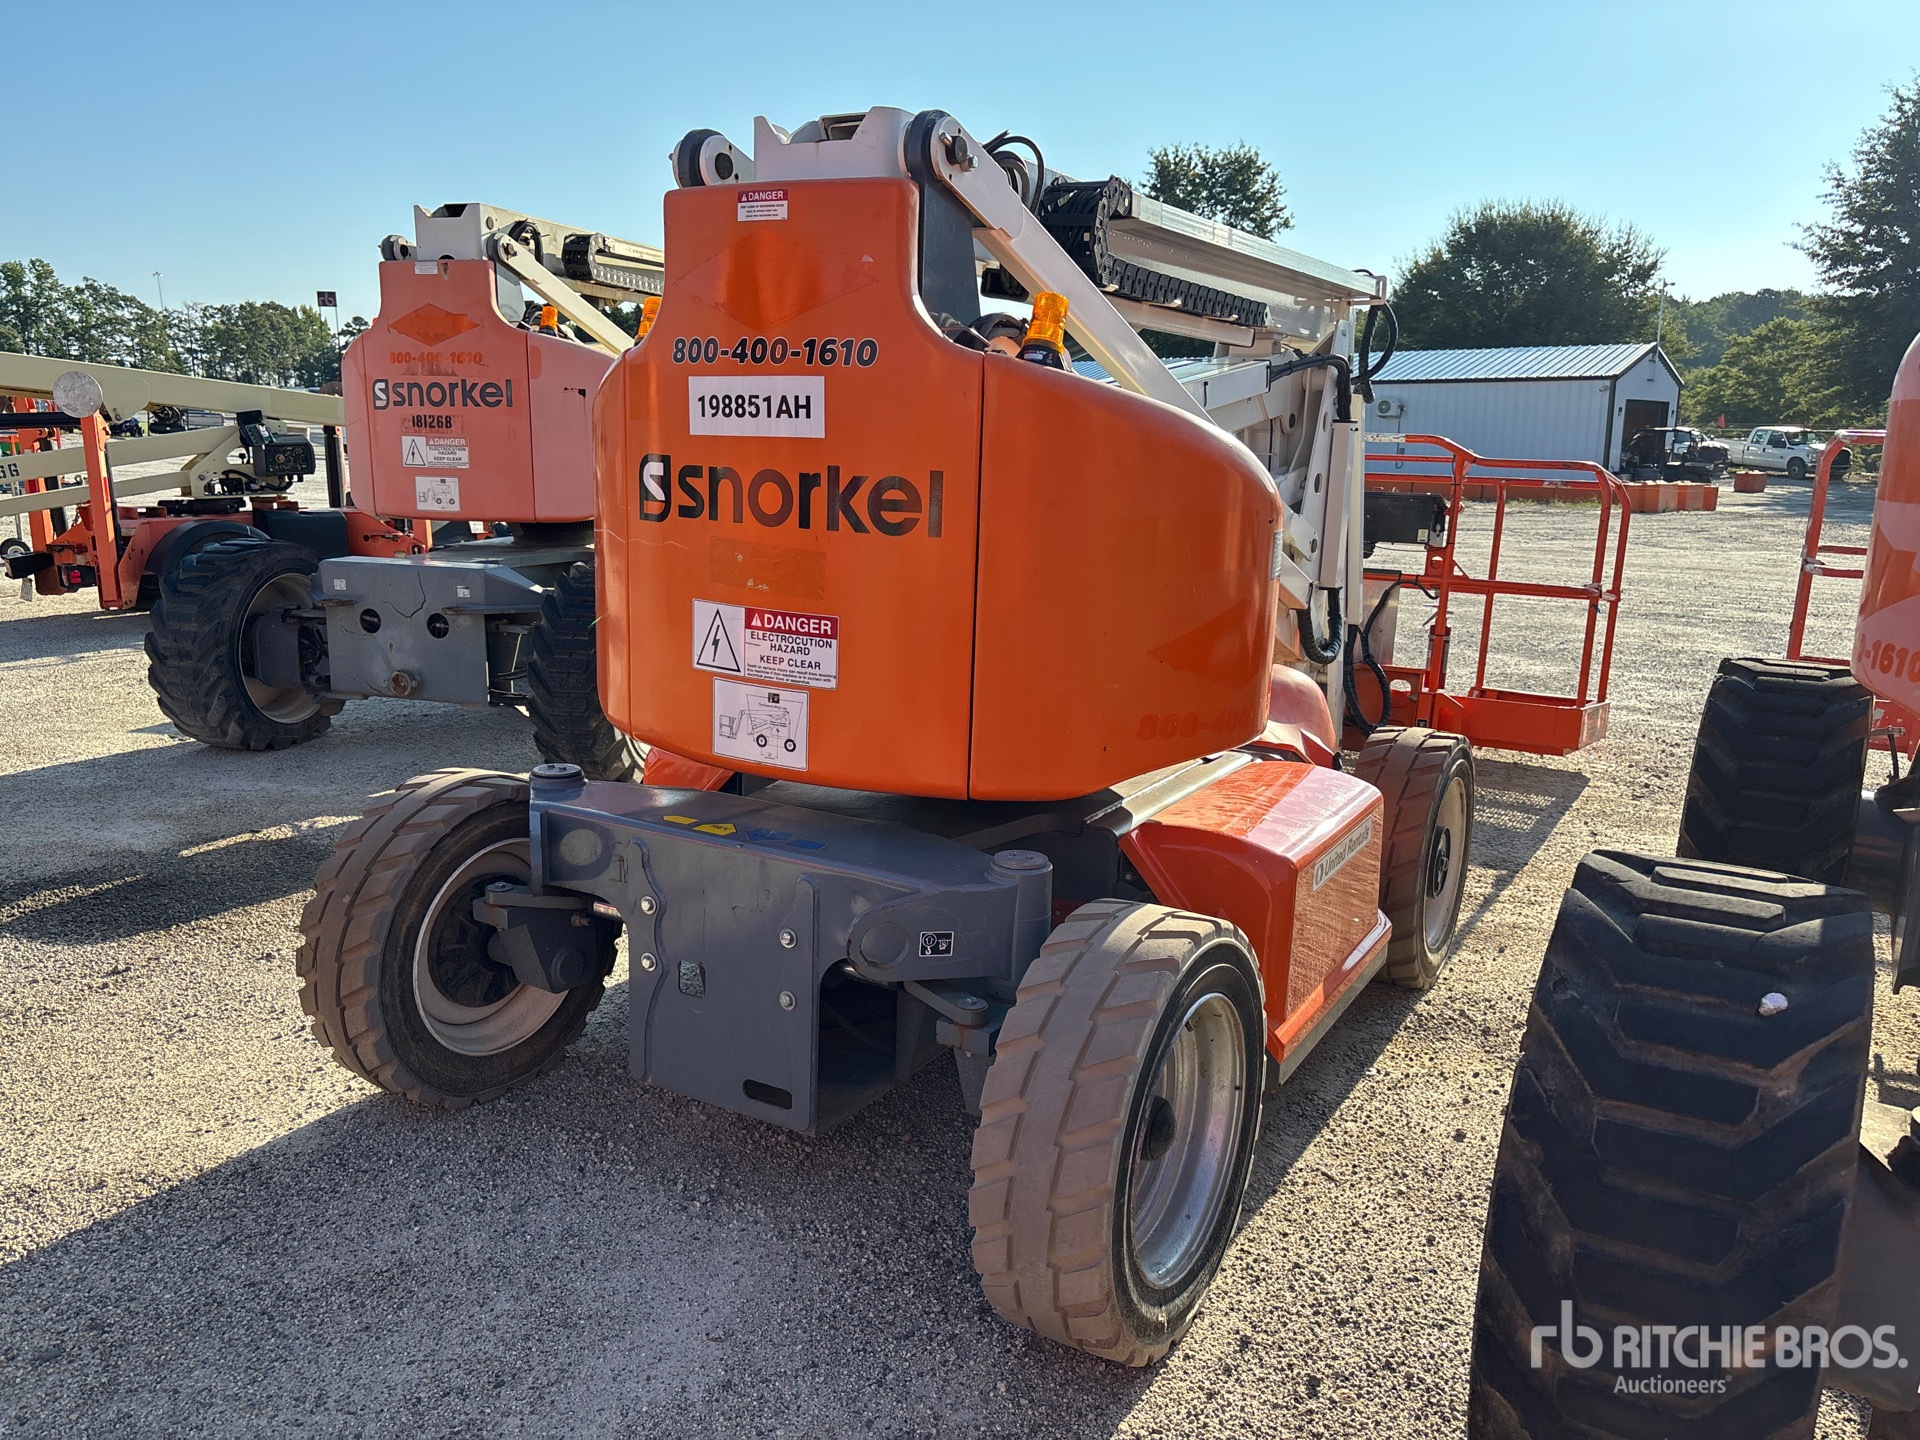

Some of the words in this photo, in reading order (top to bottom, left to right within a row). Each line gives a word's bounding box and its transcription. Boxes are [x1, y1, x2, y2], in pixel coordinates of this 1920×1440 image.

[748, 190, 784, 201] DANGER
[389, 352, 484, 364] 800-4001610
[672, 336, 879, 367] 800-400-1610
[392, 379, 513, 408] snorkel
[697, 395, 812, 419] 198851AH
[412, 414, 453, 429] 181268
[435, 438, 466, 446] DANGER
[677, 465, 944, 538] snorkel
[764, 613, 832, 635] DANGER
[750, 630, 832, 649] ELECTROCUTION
[770, 644, 811, 656] HAZARD
[759, 655, 785, 665] KEEP
[787, 658, 821, 670] CLEAR
[1325, 843, 1347, 876] United
[1347, 825, 1370, 856] Rentals
